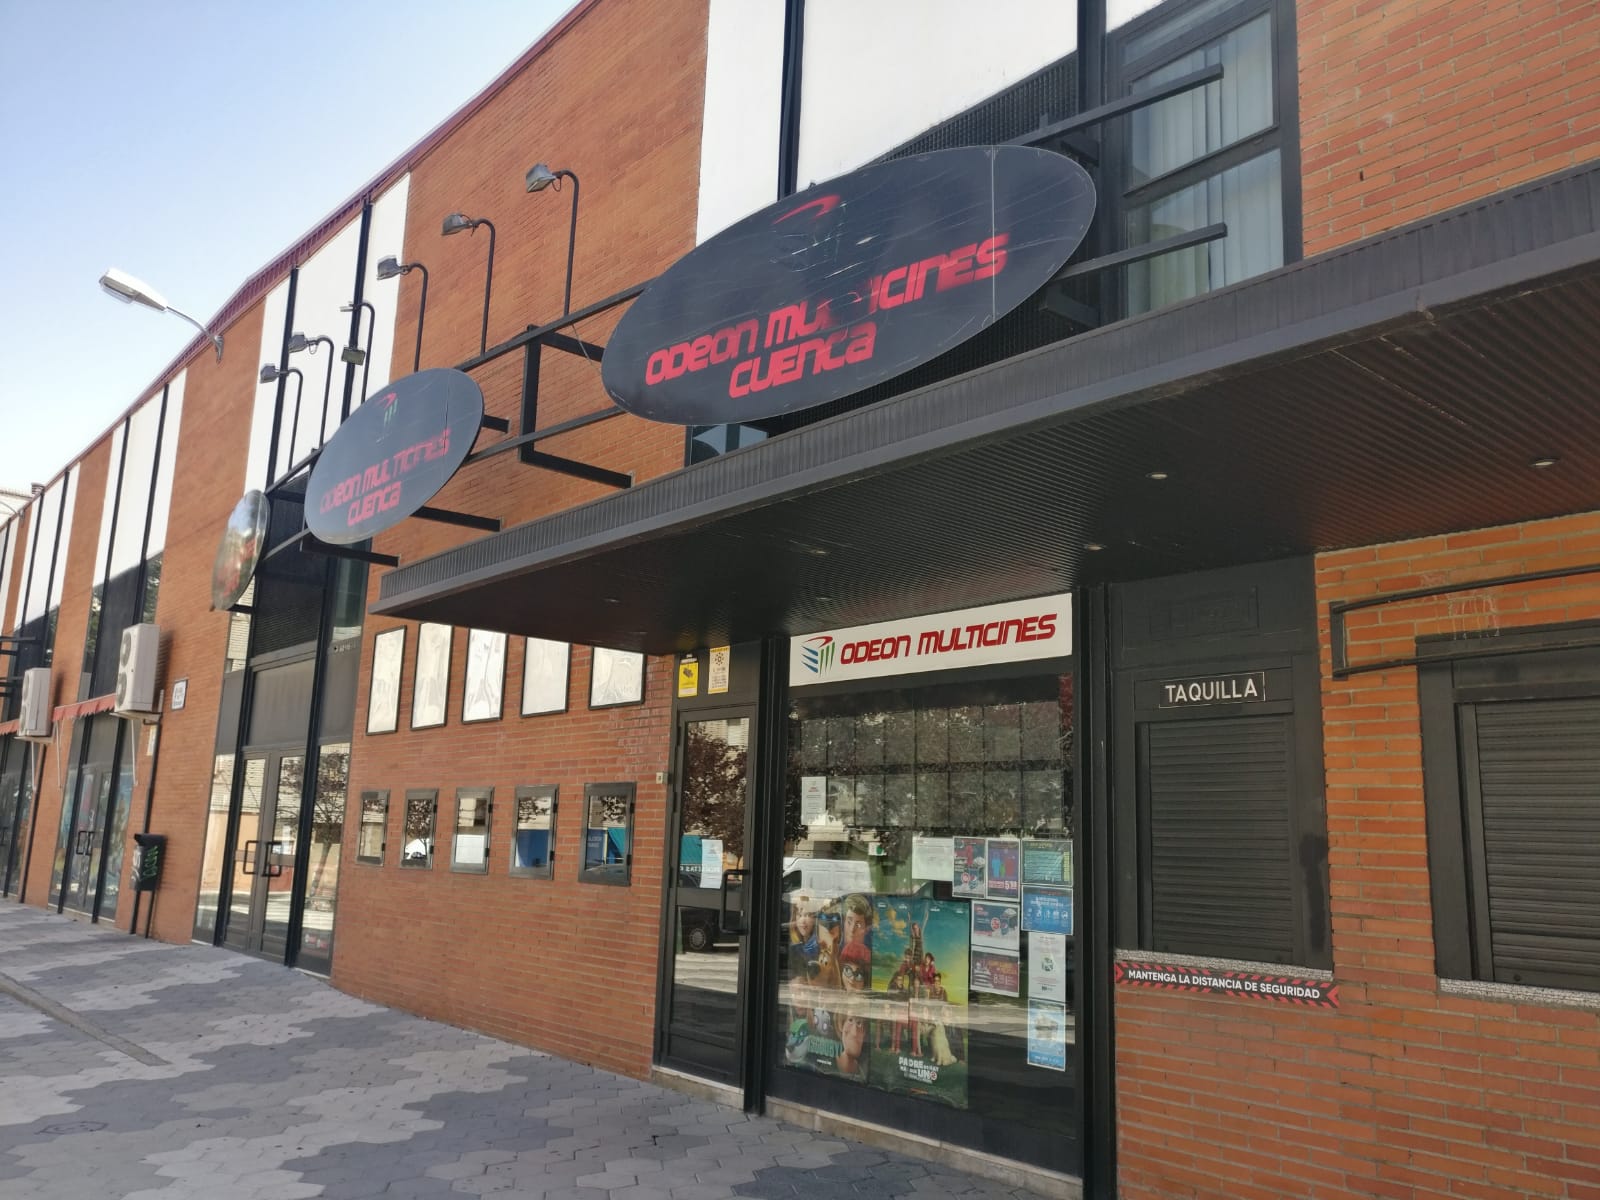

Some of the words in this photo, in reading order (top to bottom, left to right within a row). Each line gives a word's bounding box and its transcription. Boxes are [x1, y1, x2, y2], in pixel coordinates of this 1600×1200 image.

[645, 318, 759, 386] ODEON
[764, 233, 1010, 348] MUICINES
[729, 322, 878, 399] CUENCA
[840, 635, 911, 665] ODEON
[917, 613, 1057, 655] MULTICINES
[1165, 678, 1258, 703] TAQUILLA
[1128, 969, 1177, 983] MANTENGA
[1178, 974, 1191, 985] LA
[1192, 976, 1242, 990] DISTANCIA
[1244, 981, 1258, 991] DE
[1259, 983, 1320, 999] SEGURIDAD
